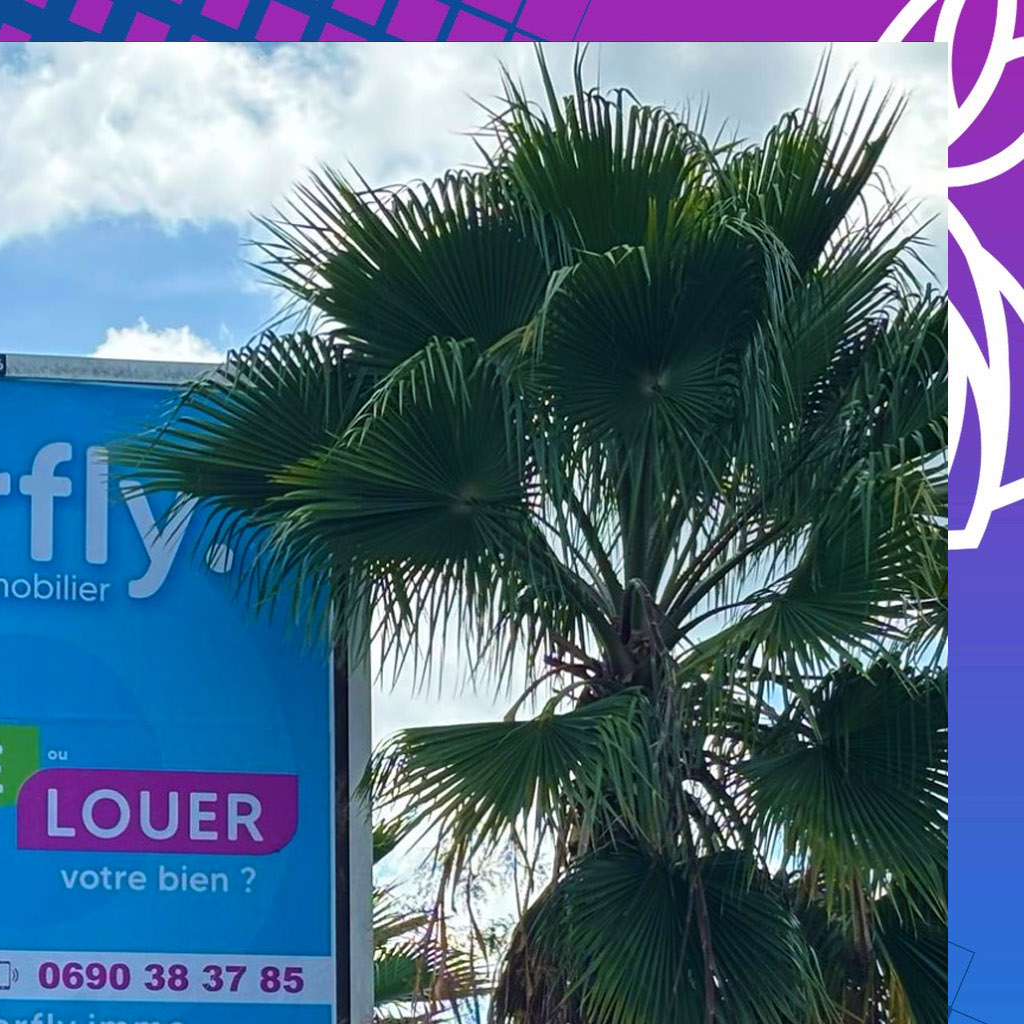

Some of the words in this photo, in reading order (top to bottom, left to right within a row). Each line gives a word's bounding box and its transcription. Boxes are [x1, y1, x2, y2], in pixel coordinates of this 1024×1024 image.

[47, 750, 68, 761] ou
[47, 788, 264, 842] LOUER
[61, 865, 147, 891] votre
[158, 865, 229, 892] bien
[240, 866, 257, 893] ?
[38, 961, 132, 990] 0690
[144, 963, 190, 992] 38
[202, 964, 248, 993] 37
[259, 965, 305, 995] 85
